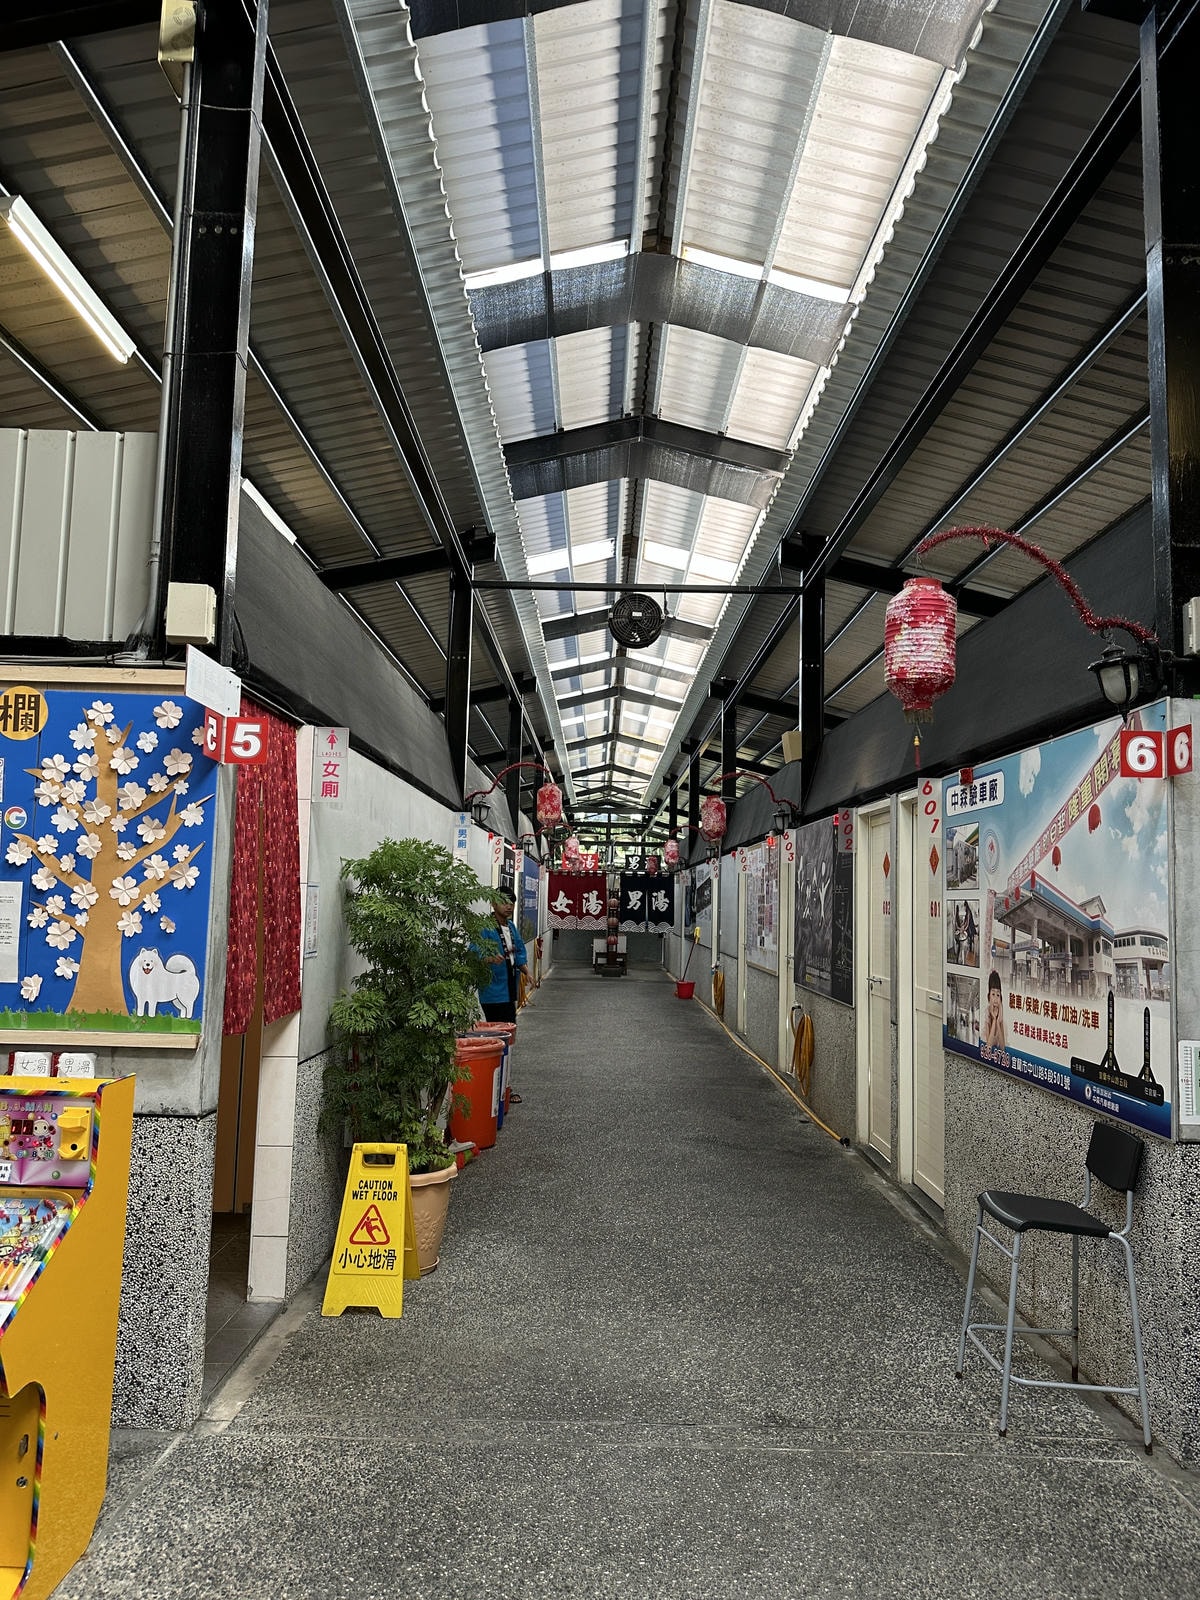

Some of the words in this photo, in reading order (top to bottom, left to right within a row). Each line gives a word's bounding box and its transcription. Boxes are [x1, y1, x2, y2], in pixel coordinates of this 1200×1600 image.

[0, 693, 40, 732] 欄
[230, 722, 262, 759] 5
[1126, 736, 1157, 773] 6
[1174, 731, 1190, 770] 6
[321, 760, 341, 798] 女廁
[951, 778, 998, 811] 中森驗車廠
[5, 806, 27, 829] G
[922, 780, 940, 834] 601
[841, 809, 853, 850] 602
[783, 831, 795, 862] 603
[550, 890, 603, 915] 女湯
[626, 890, 669, 912] 男湯
[352, 1190, 369, 1200] WET
[372, 1191, 398, 1201] FLOOR
[358, 1179, 393, 1190] CAUTION
[338, 1247, 397, 1271] 小心地滑
